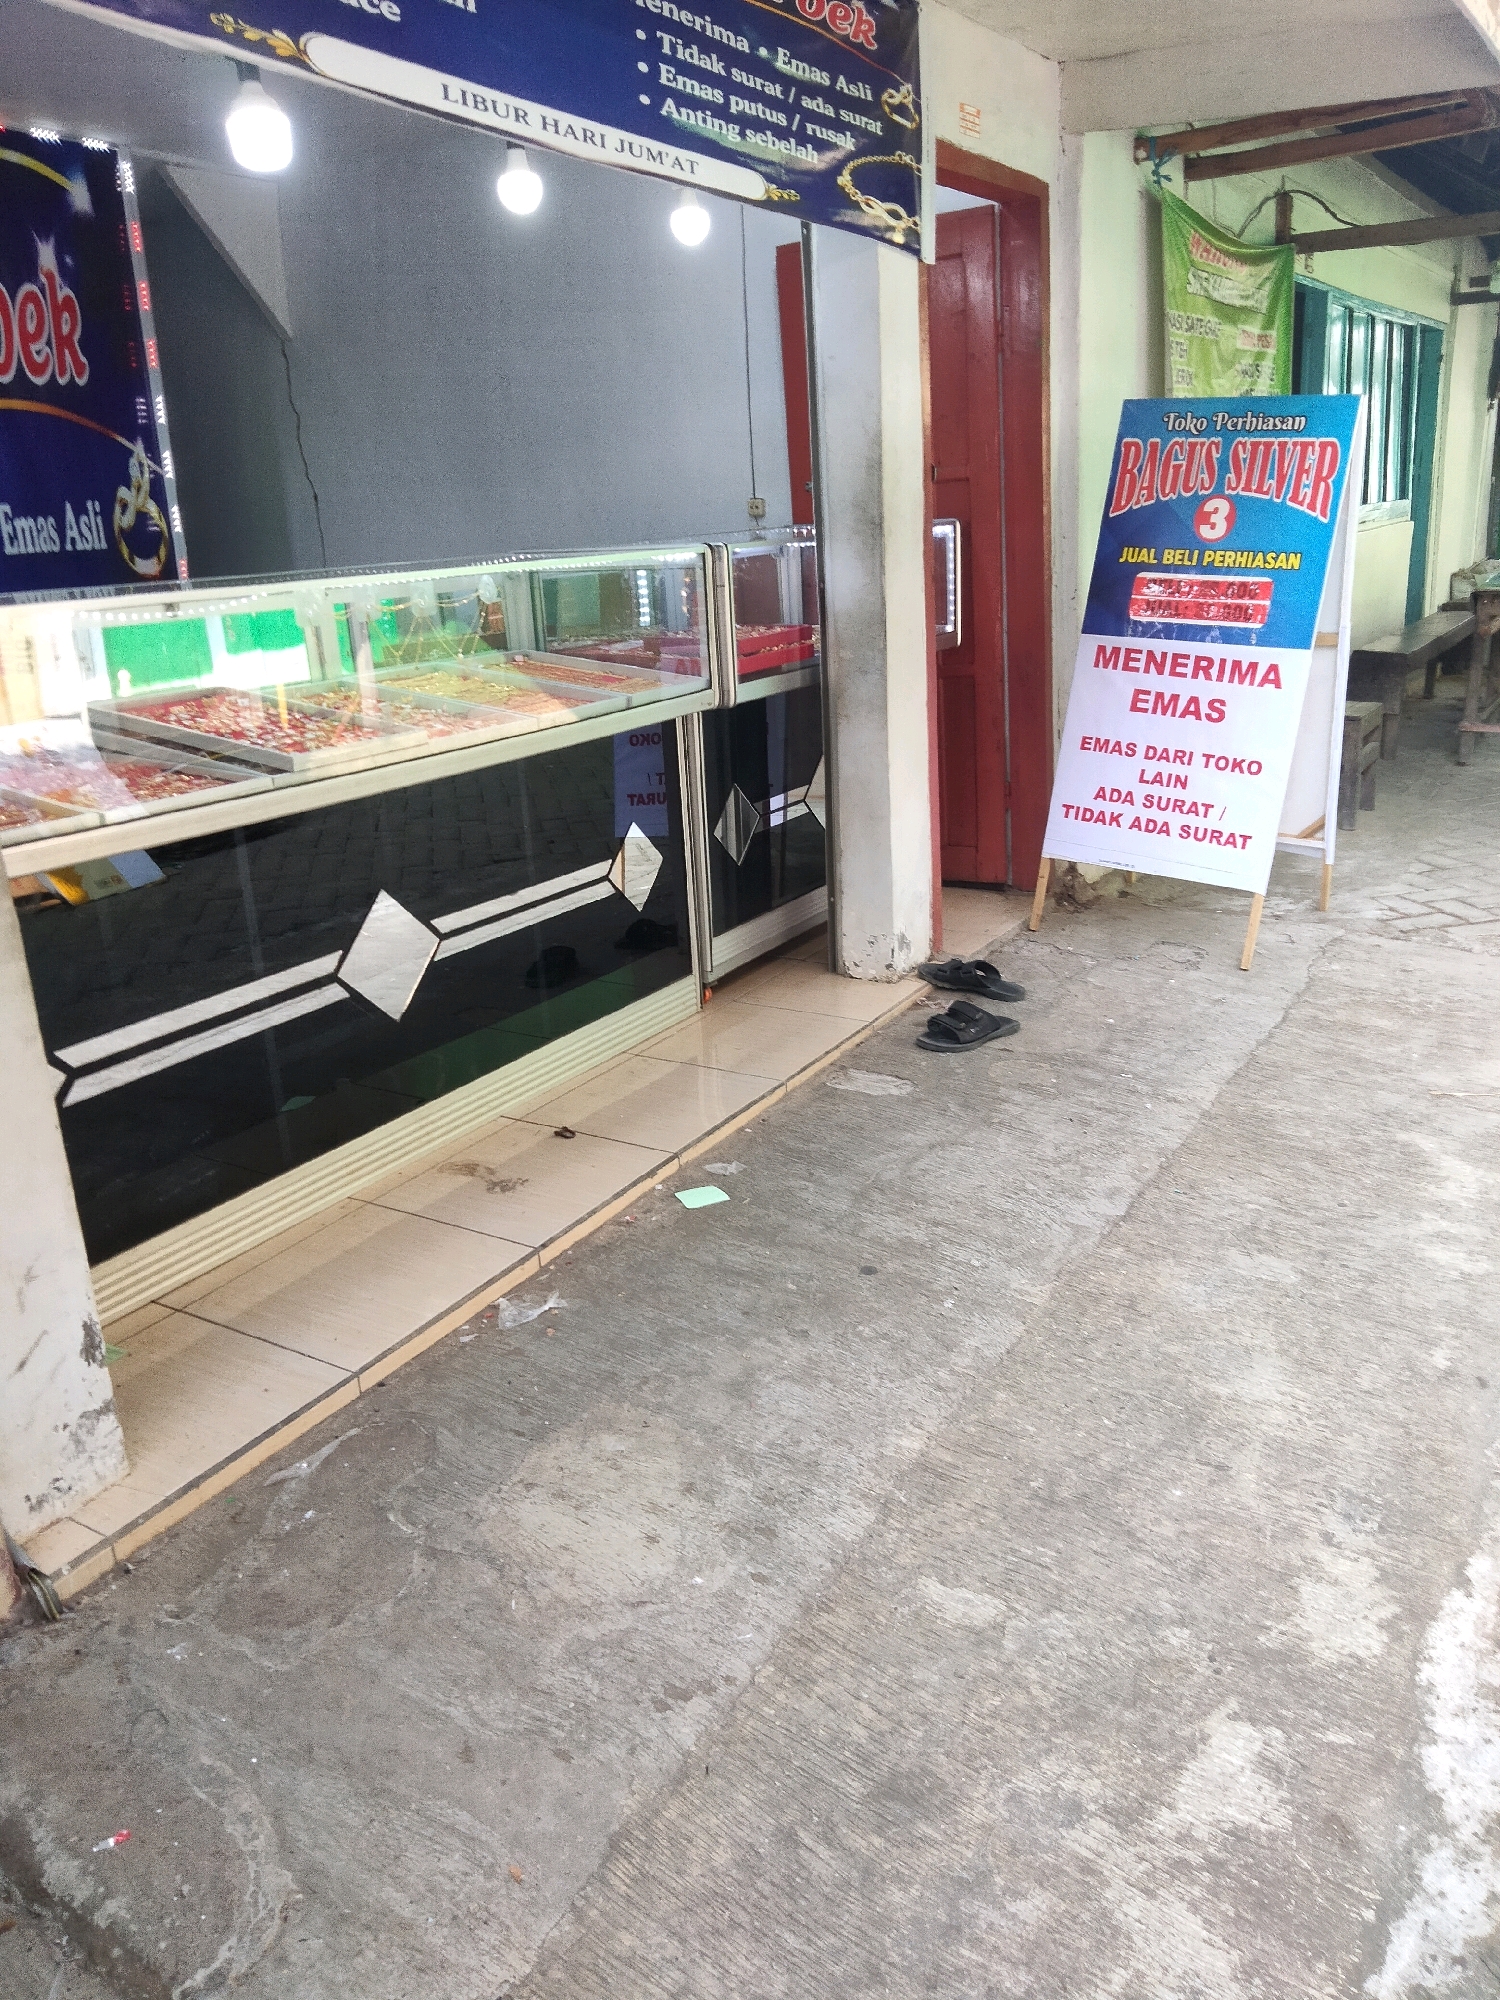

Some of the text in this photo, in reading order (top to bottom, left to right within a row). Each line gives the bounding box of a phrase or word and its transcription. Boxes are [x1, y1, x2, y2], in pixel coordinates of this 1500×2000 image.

[772, 0, 878, 50] oek
[634, 0, 874, 102] enerima Emas Asli
[656, 31, 883, 136] Tidak surat / ada surat
[658, 63, 857, 151] Emas putus / rusak
[441, 82, 700, 176] LIBUR HARI JUM'AT
[659, 97, 819, 164] Anting sebelah
[1163, 411, 1308, 434] Toko Perhiasan
[1108, 437, 1341, 524] BAGUS SILVER
[0, 498, 108, 556] Emas Asli
[1199, 498, 1230, 540] 3
[1118, 546, 1302, 572] JUAL BELI PERHIASAN
[1092, 644, 1284, 690] MENERIMA
[1128, 688, 1227, 724] EMAS
[1079, 735, 1264, 777] EMAS DARI TOKO
[1138, 768, 1189, 791] LAIN
[1060, 803, 1254, 851] TIDAK ADA SURAT
[1092, 785, 1227, 821] ADA SURAT /
